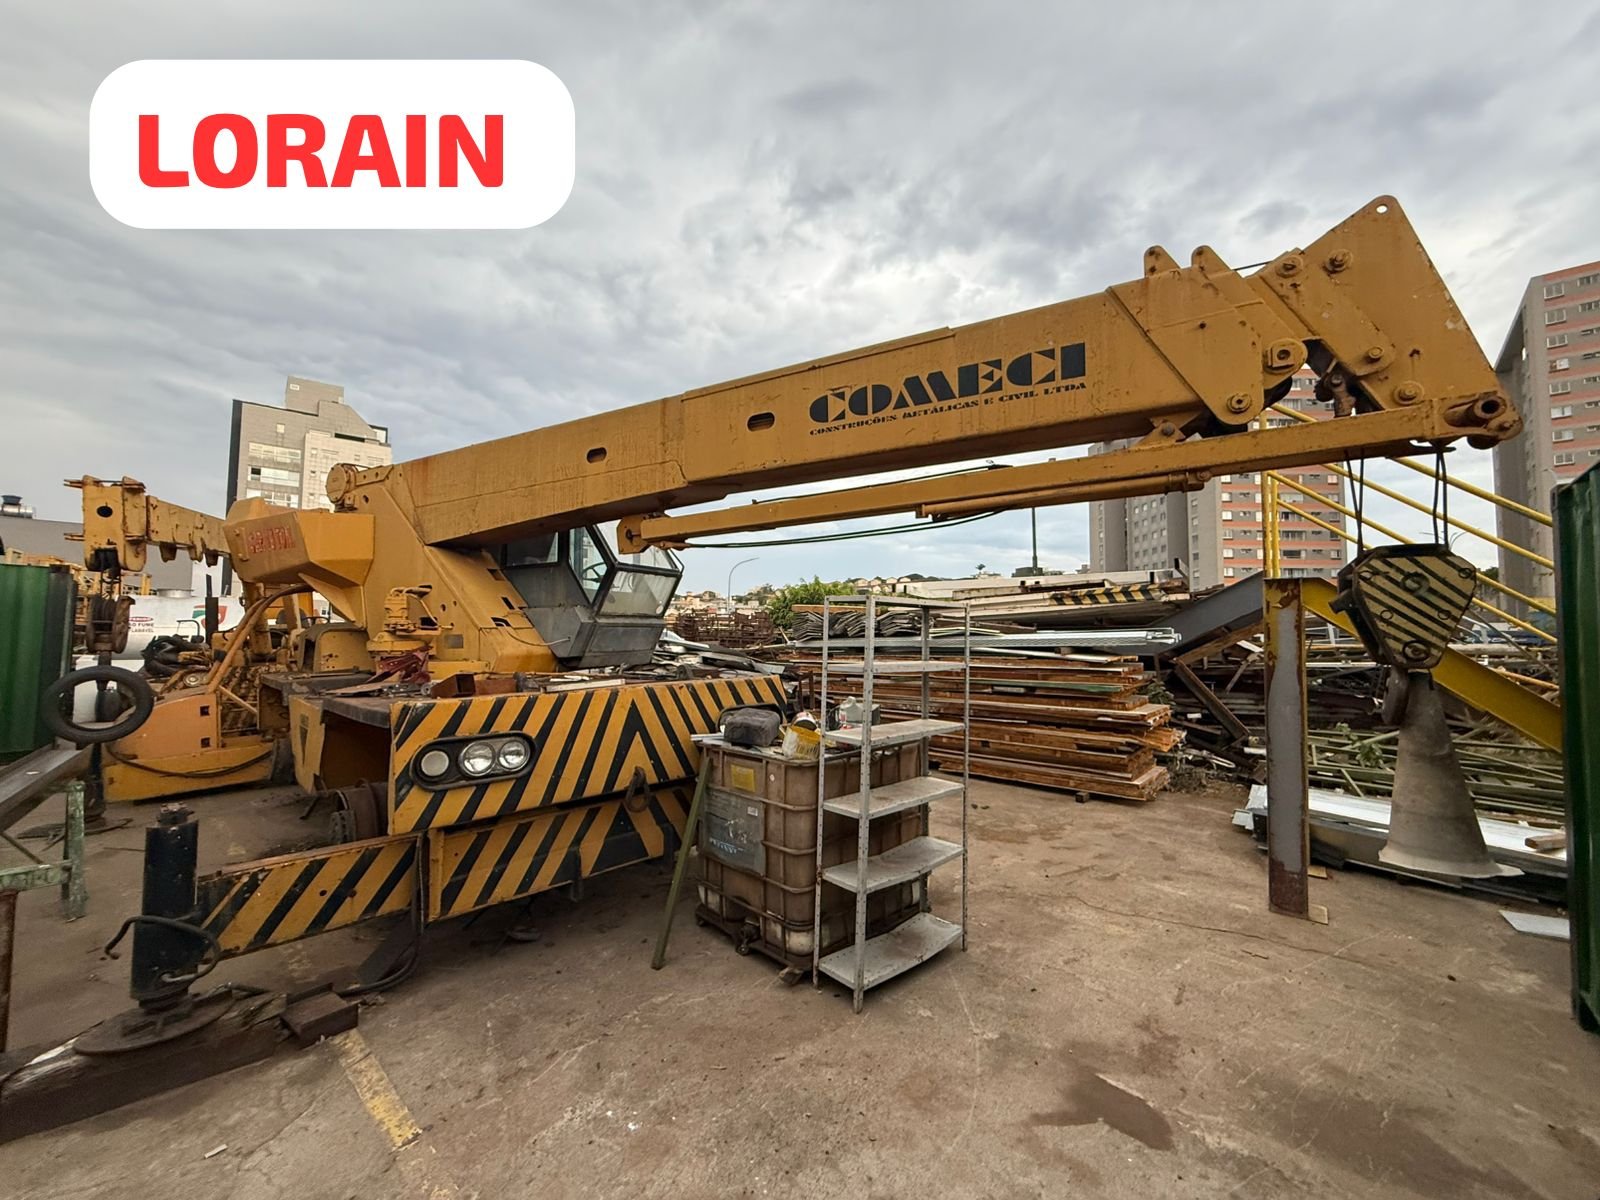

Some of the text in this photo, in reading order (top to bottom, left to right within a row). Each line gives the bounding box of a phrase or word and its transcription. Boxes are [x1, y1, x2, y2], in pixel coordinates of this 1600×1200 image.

[809, 342, 1086, 423] COMECI
[809, 414, 897, 436] CONSTRUÇÕES
[998, 390, 1039, 402] CIVIL
[1043, 382, 1086, 395] LTDA
